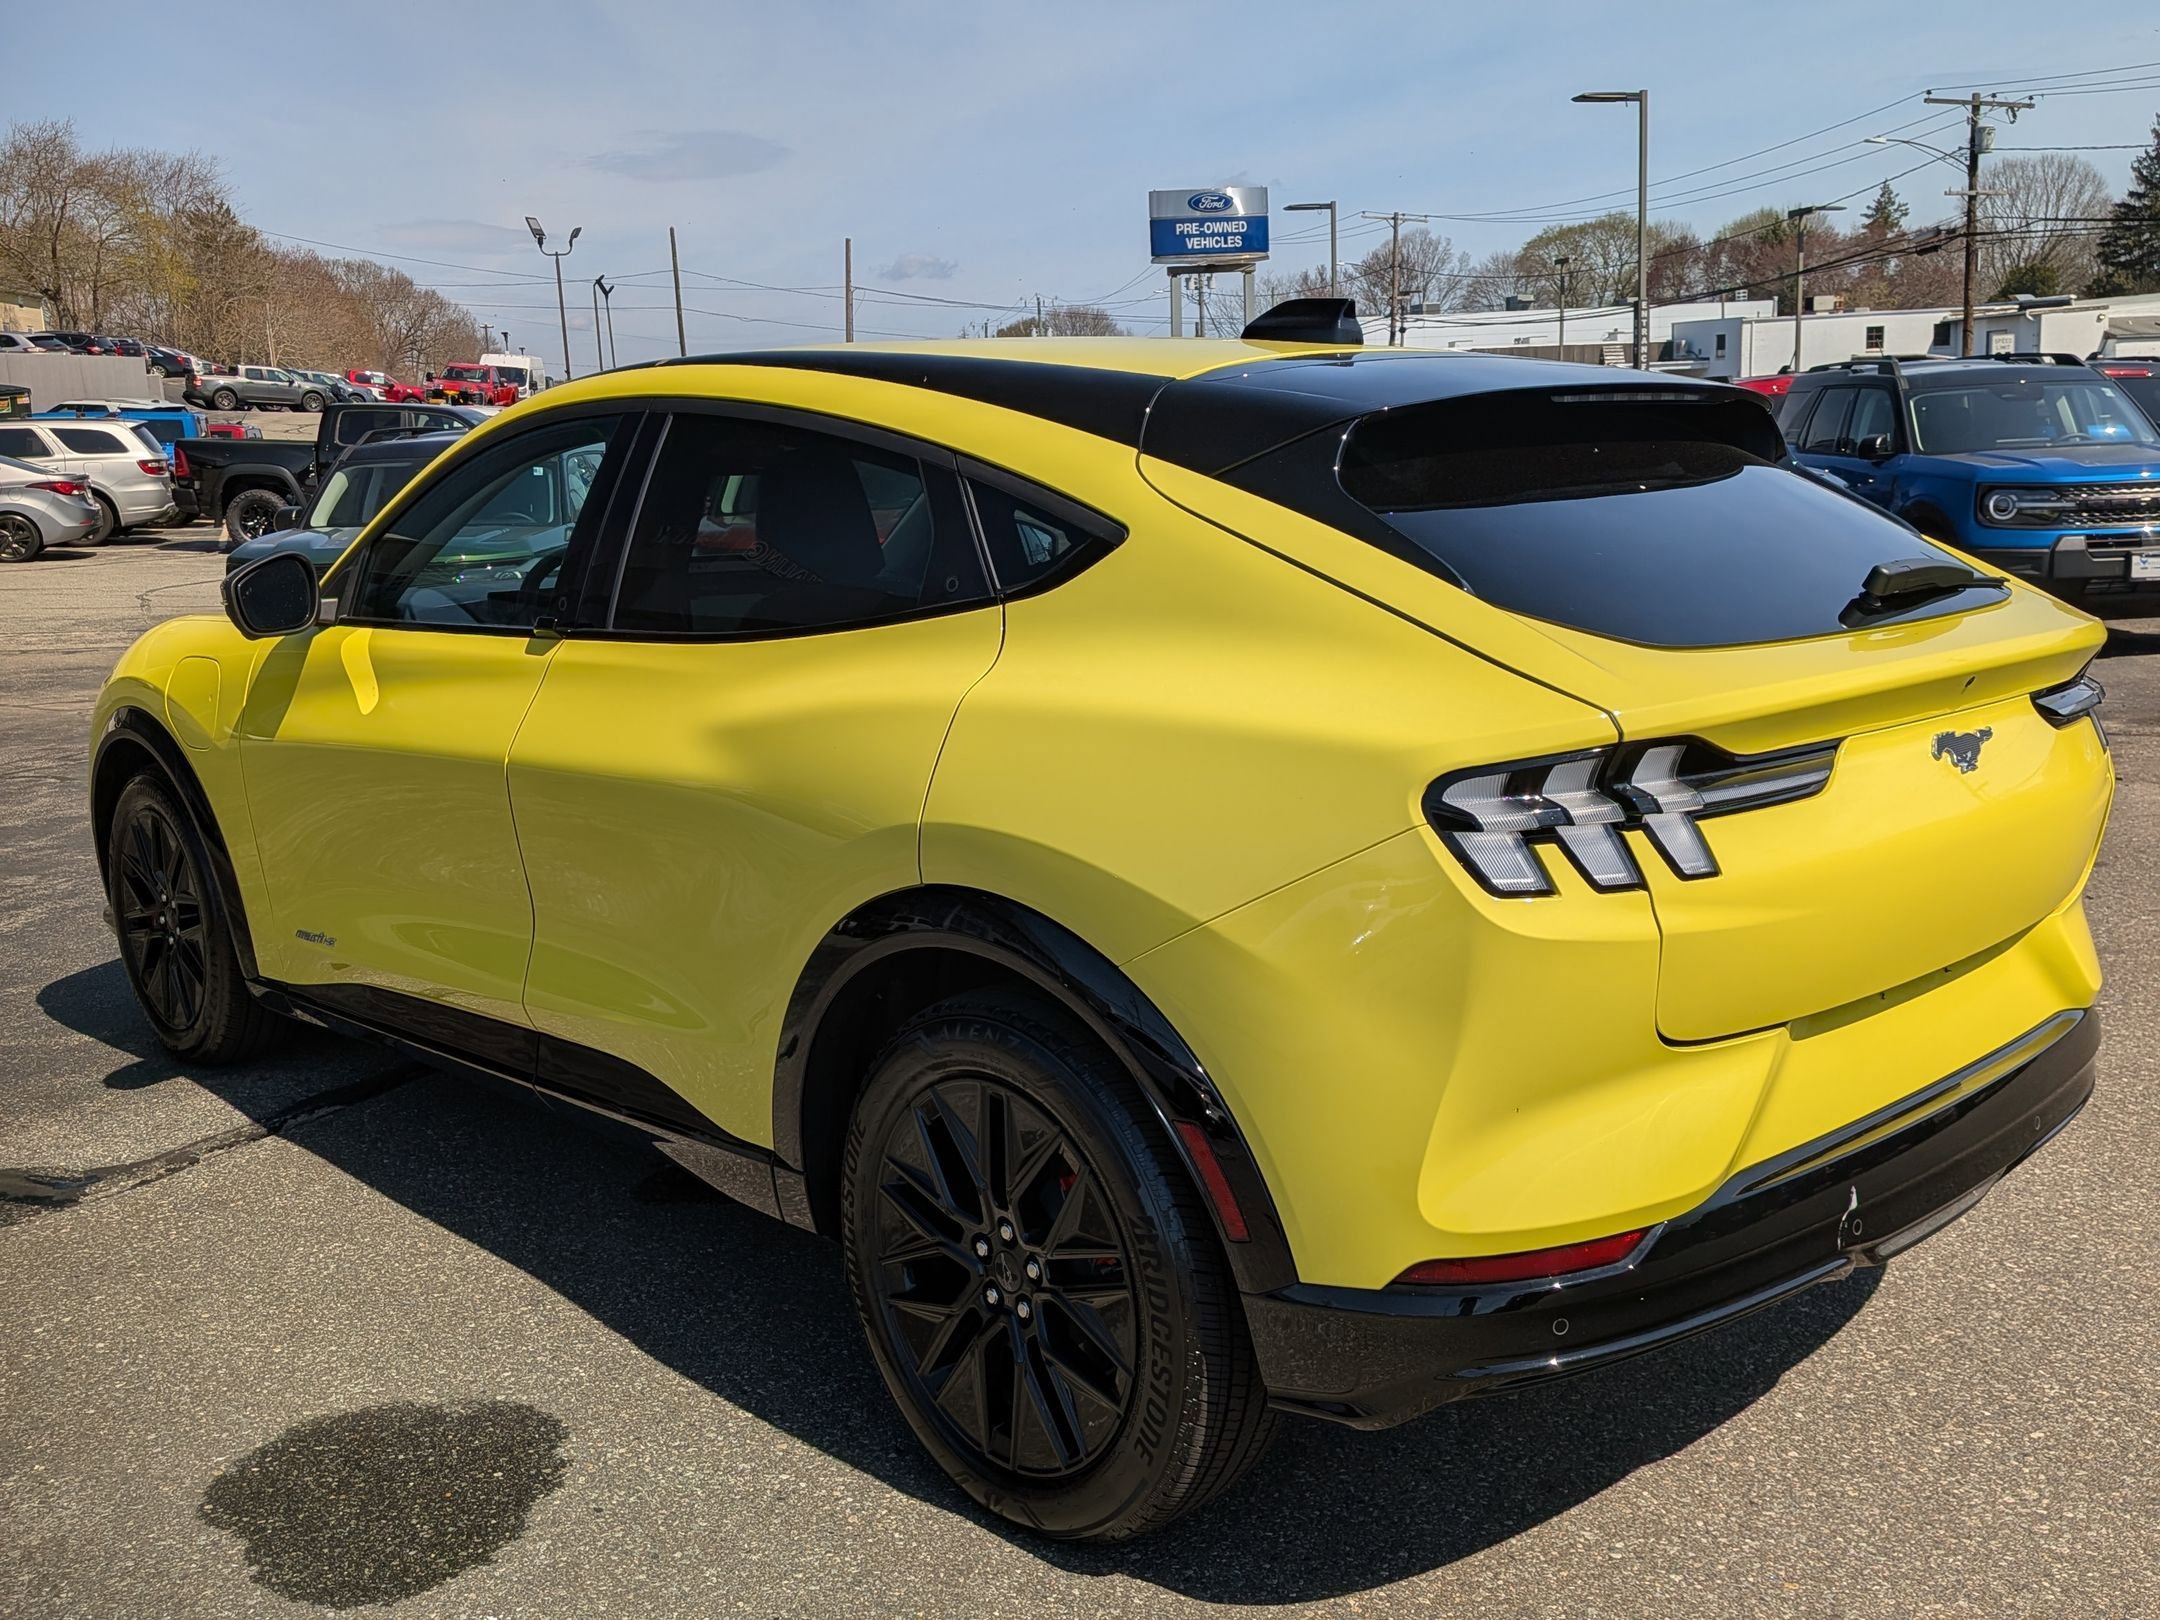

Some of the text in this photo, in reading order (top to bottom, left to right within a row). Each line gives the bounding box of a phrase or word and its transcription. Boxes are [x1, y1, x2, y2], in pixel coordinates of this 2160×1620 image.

[1199, 195, 1225, 209] Ford
[1175, 221, 1248, 235] PRE-OWNED
[1185, 236, 1243, 249] VEHICLES
[1128, 1215, 1174, 1468] BRIDGESTONE
